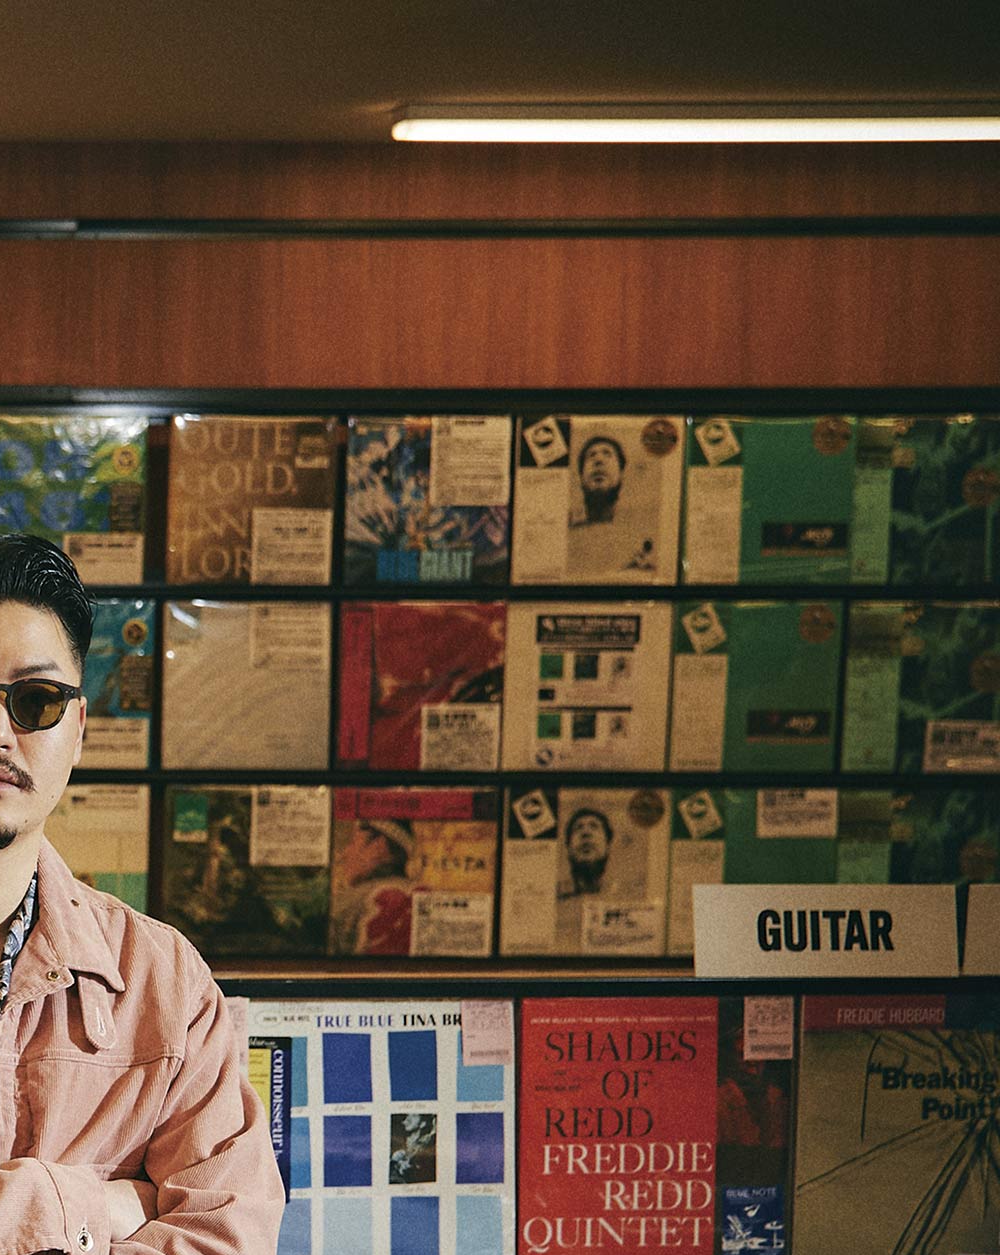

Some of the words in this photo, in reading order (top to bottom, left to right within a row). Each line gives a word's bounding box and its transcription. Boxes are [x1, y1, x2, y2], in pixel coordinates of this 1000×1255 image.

[756, 909, 895, 952] GUITAR
[316, 1014, 351, 1029] TRUE
[358, 1013, 395, 1028] BLUE
[402, 1013, 437, 1027] TINA
[836, 1008, 886, 1024] FREDDIE
[889, 1008, 946, 1024] HUBBARD
[544, 1030, 698, 1063] SHADES
[601, 1069, 653, 1100] OF
[544, 1106, 654, 1139] REDD
[541, 1142, 714, 1175] FREDDIE
[603, 1180, 713, 1212] REDD
[522, 1217, 713, 1254] QUINTET
